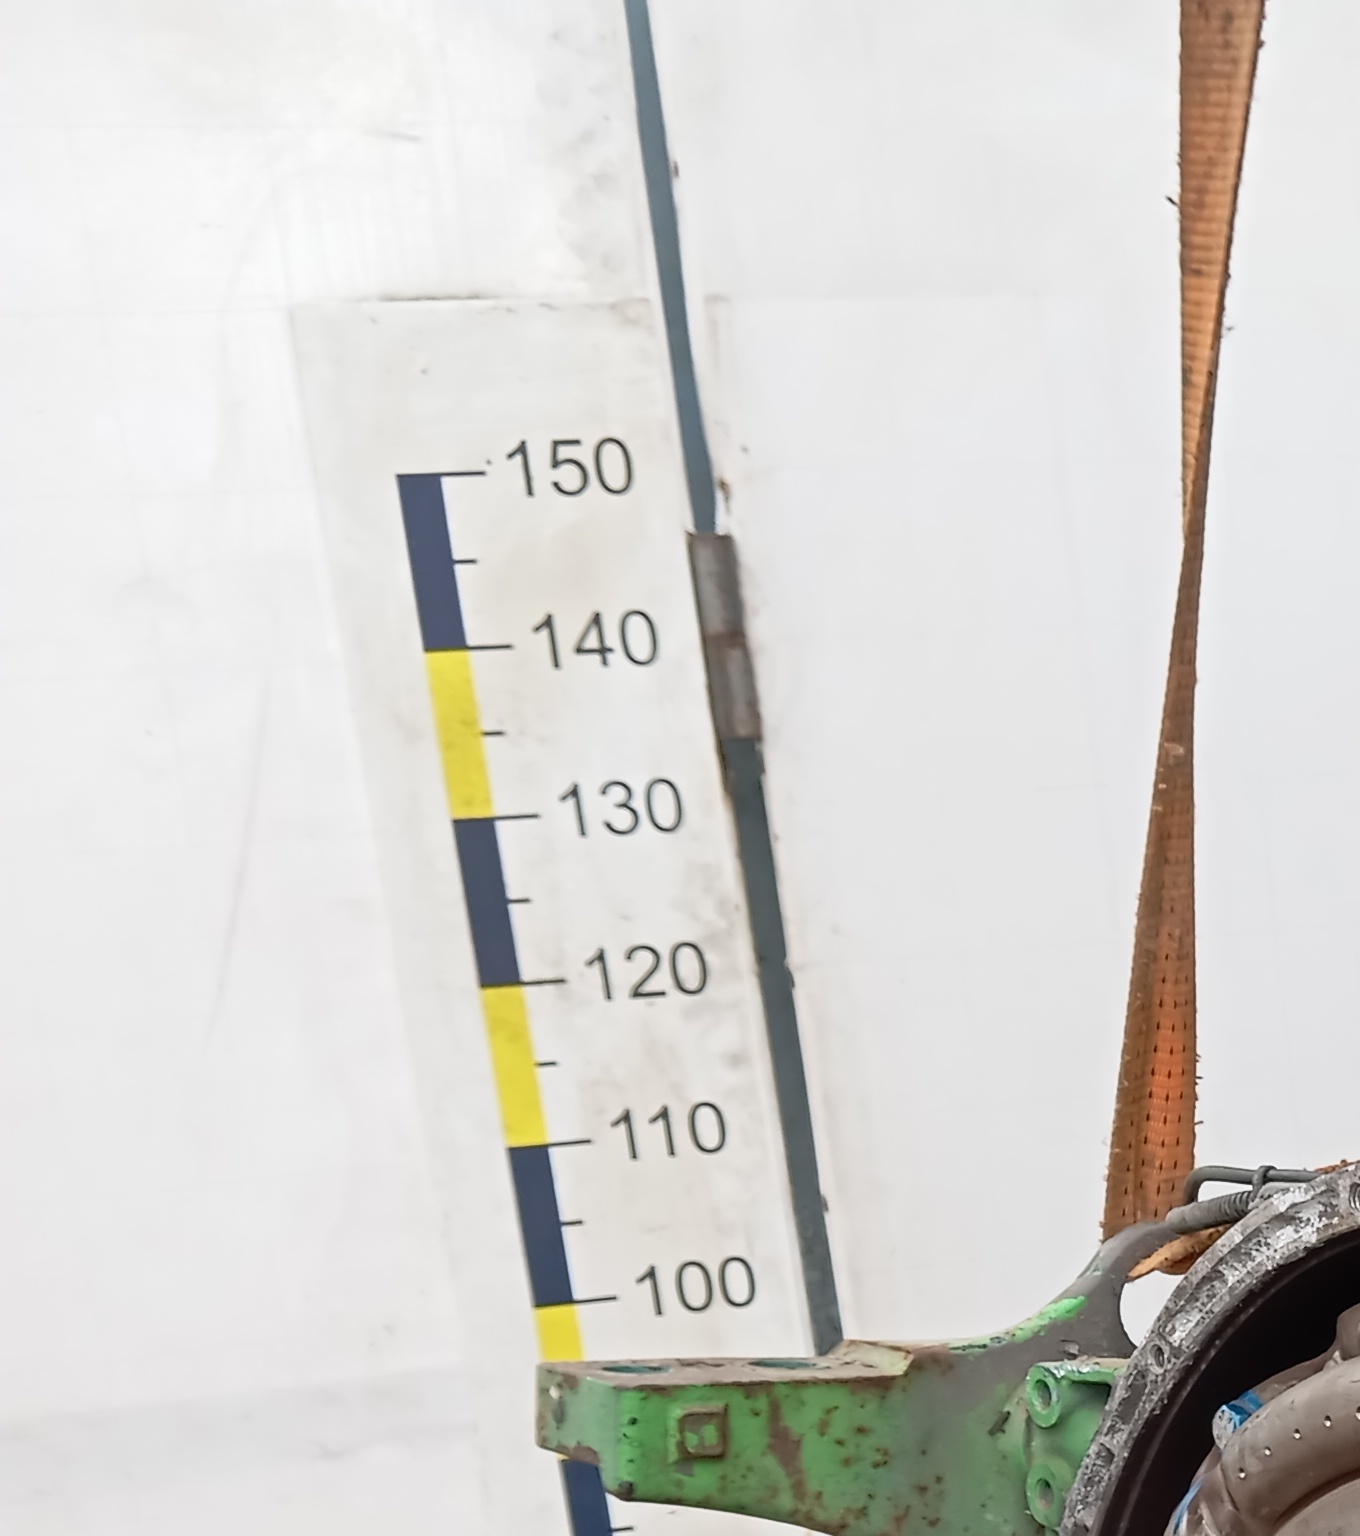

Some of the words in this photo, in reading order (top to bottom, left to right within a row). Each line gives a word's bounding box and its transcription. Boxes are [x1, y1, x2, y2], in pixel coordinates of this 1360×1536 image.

[506, 437, 634, 497] 150
[532, 610, 659, 670] 140
[559, 778, 684, 838] 130
[585, 941, 710, 1002] 120
[610, 1102, 726, 1161] 110
[636, 1256, 756, 1317] 100
